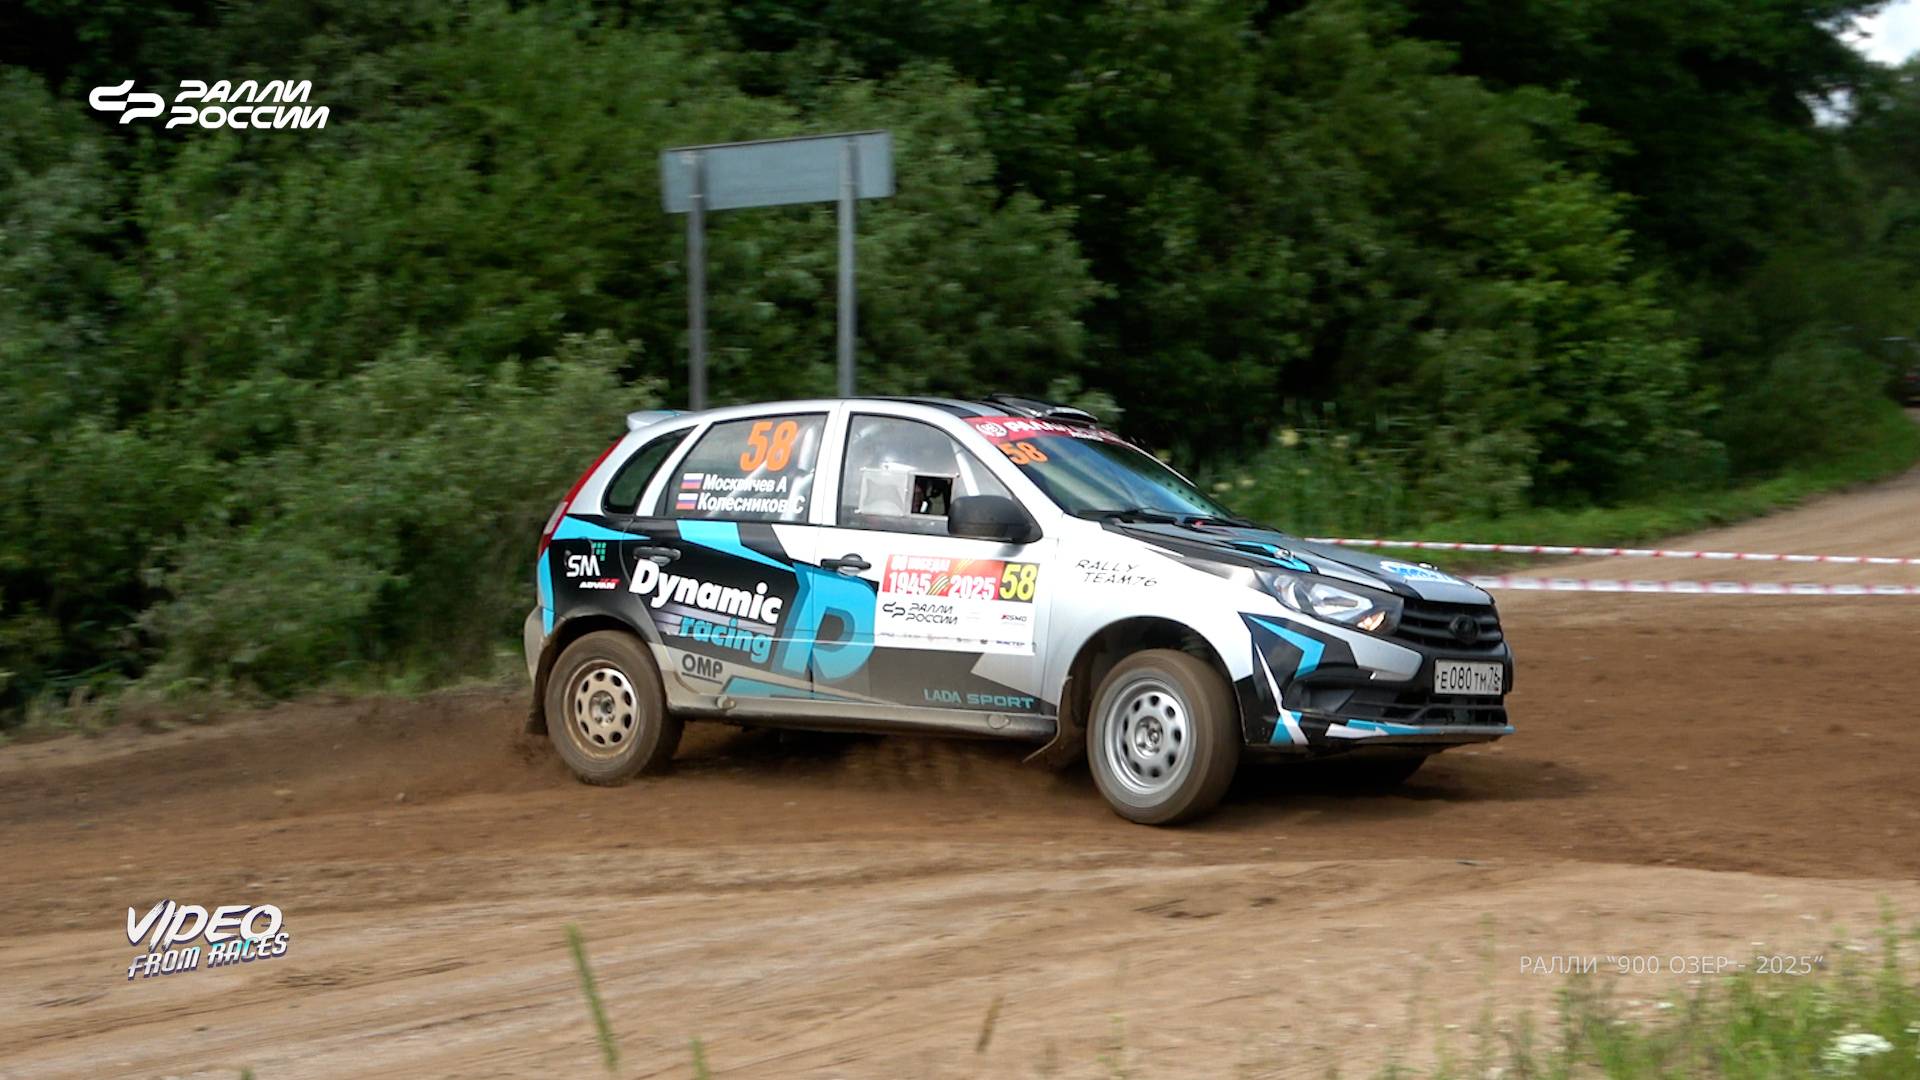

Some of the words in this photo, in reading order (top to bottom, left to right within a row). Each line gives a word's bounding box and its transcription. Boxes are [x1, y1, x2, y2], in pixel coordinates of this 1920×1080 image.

[740, 420, 798, 472] 58
[998, 442, 1048, 465] 58
[702, 474, 775, 492] Москвичев
[697, 492, 785, 513] Колесников
[566, 554, 601, 577] SM
[1075, 559, 1138, 573] RALLY
[889, 571, 933, 596] 1945
[949, 574, 997, 601] 2025
[1000, 563, 1038, 601] 58
[1083, 571, 1158, 587] TEAM76
[629, 559, 783, 625] Dynamic
[905, 612, 959, 625] РОССИИ
[909, 602, 954, 615] РАЛЛИ
[679, 616, 773, 664] racing
[682, 653, 724, 679] OMP
[924, 688, 961, 703] LADA
[966, 694, 1034, 709] SPORT
